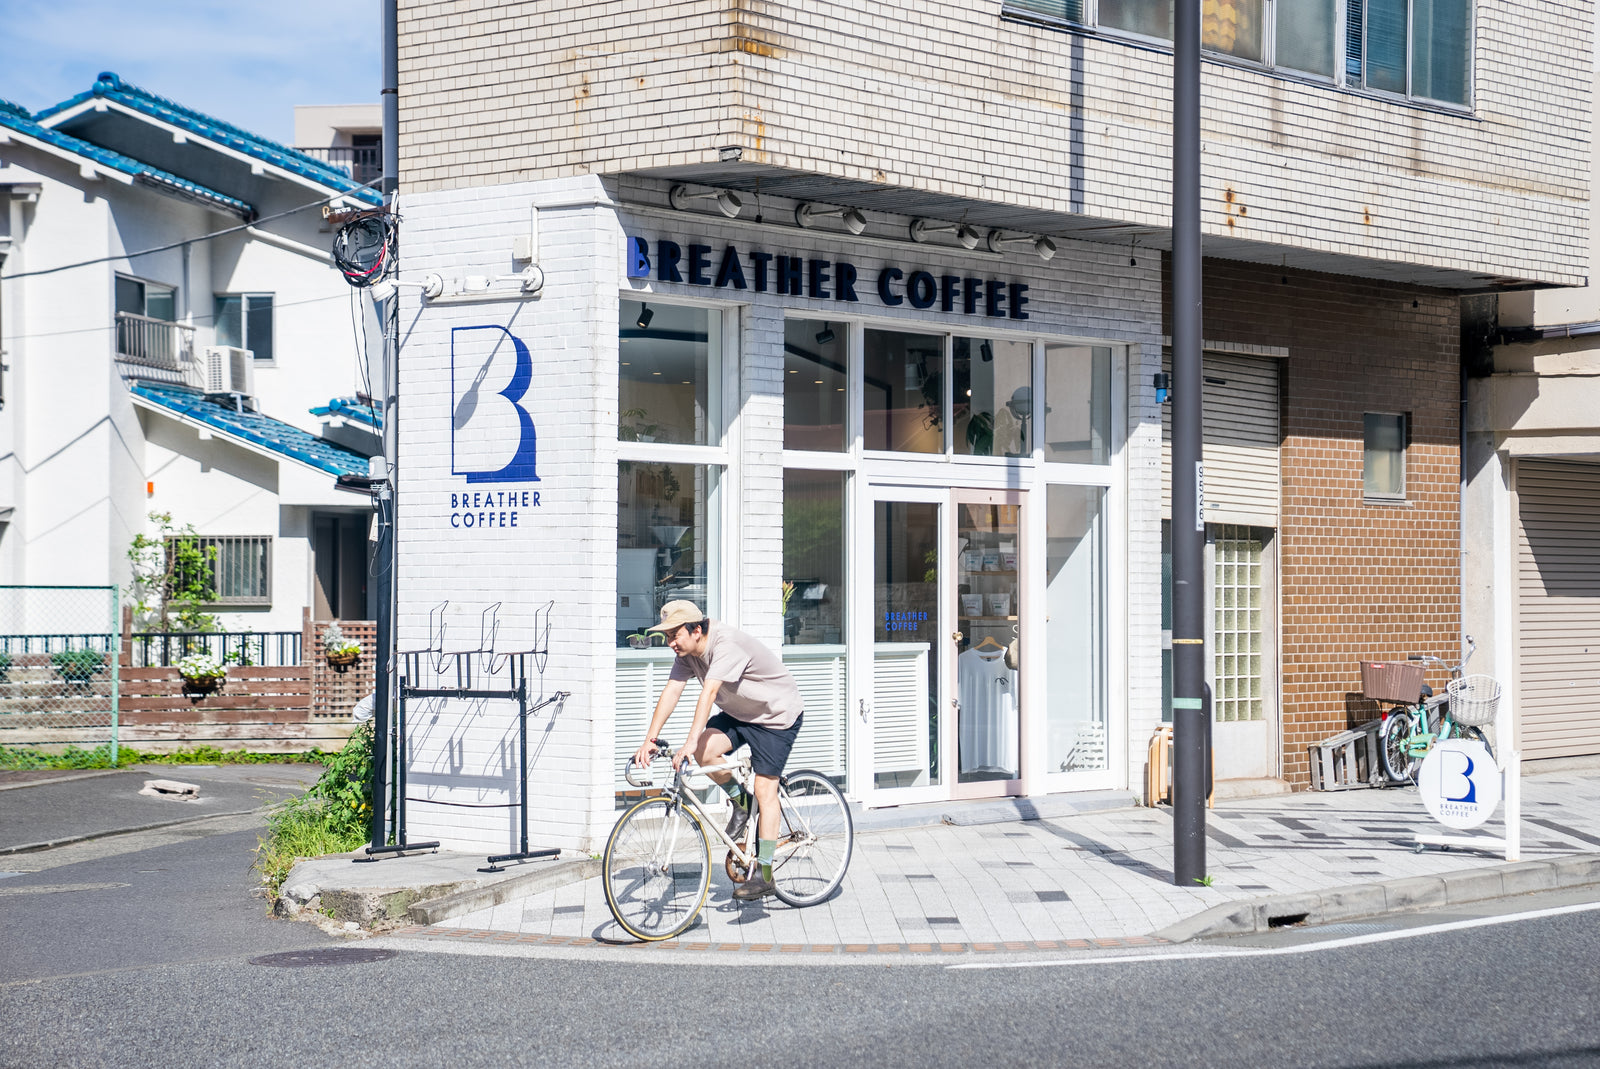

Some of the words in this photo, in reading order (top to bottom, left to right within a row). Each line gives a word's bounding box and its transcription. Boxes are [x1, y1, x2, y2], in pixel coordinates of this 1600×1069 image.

[627, 236, 859, 302] BREATHER
[877, 267, 1029, 320] COFFEE
[451, 491, 541, 509] BREATHER
[451, 512, 518, 528] COFFEE
[885, 611, 928, 621] BREATHER
[885, 622, 918, 631] COFFEE
[1440, 803, 1478, 812] BREATHER
[1440, 810, 1469, 818] COFFEE
